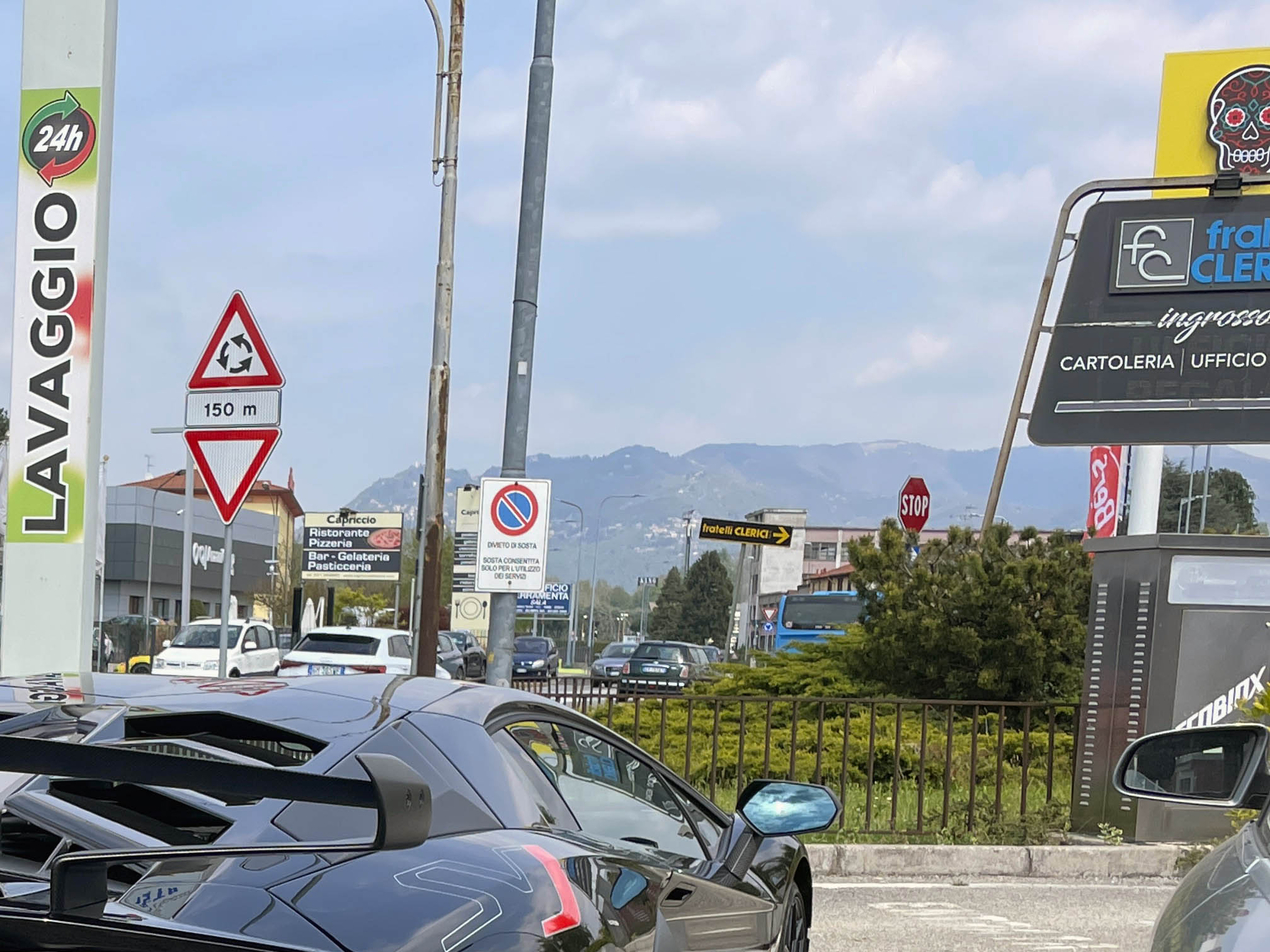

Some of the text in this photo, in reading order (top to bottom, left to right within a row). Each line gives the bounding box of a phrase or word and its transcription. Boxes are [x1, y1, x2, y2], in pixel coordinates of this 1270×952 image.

[33, 124, 84, 152] 24h
[1157, 307, 1270, 344] ingrosso
[25, 193, 78, 532] LAVAGGIO
[1060, 353, 1267, 371] CARTOLERIA UFFICIO
[204, 402, 257, 417] 150 m
[902, 494, 928, 517] STOP
[327, 514, 376, 526] Capriccio
[309, 528, 370, 537] Ristorante
[702, 523, 770, 539] fratelli CLERICI
[309, 538, 353, 548] Pizzeria
[487, 541, 510, 549] DIVIETO
[308, 551, 330, 561] Bar
[337, 552, 390, 561] Gelateria
[307, 561, 371, 571] Pasticceria
